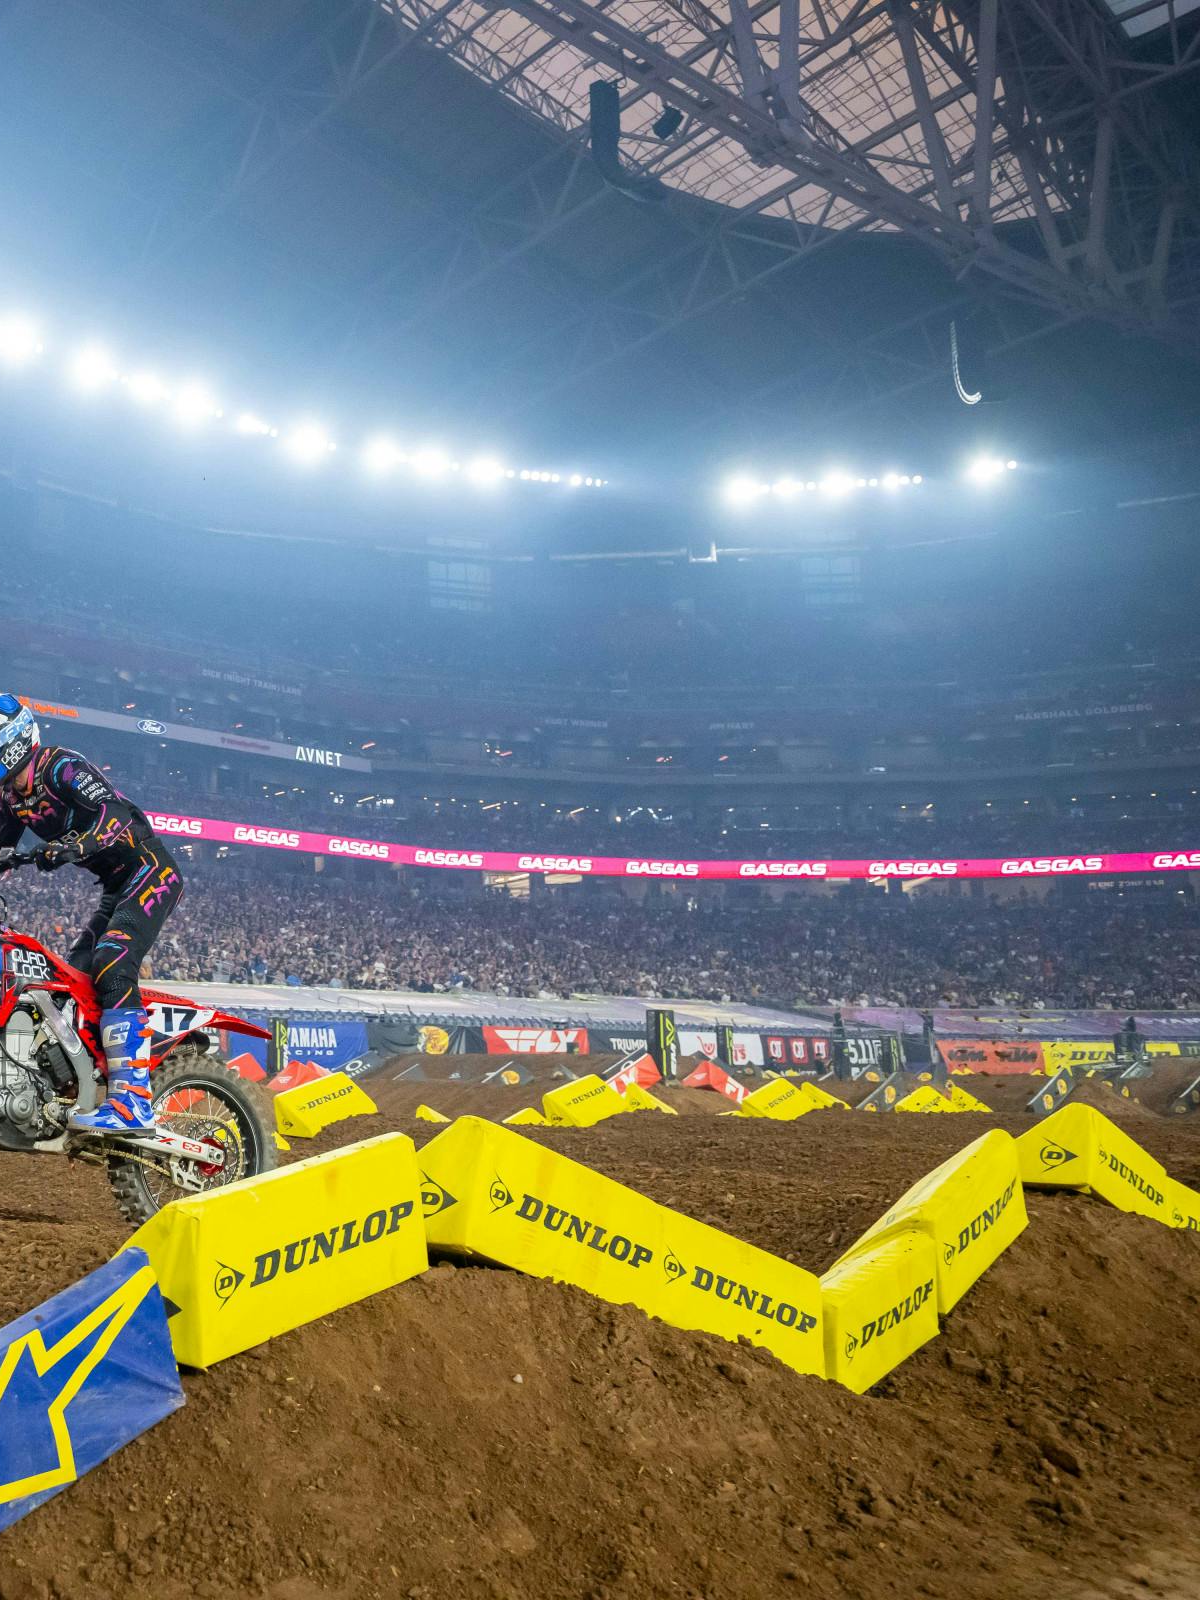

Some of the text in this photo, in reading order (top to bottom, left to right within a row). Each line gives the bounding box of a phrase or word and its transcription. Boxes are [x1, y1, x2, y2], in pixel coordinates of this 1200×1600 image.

[296, 746, 343, 767] AVNET
[147, 815, 203, 835] ASGAS
[234, 827, 300, 847] GASGAS
[328, 839, 389, 858] GASGAS
[414, 850, 484, 867] GASGAS
[517, 856, 593, 872] GASGAS
[625, 861, 699, 876] GASGAS
[739, 863, 827, 876] GASGAS
[868, 863, 958, 876] GASGAS
[1001, 857, 1103, 874] GASGAS
[1153, 853, 1200, 868] GAS
[11, 948, 47, 967] QUAD
[12, 962, 51, 980] LOCK
[161, 1006, 198, 1033] 17
[308, 1085, 355, 1109] DUNLOP
[571, 1085, 606, 1105] DUNLOP
[1109, 1153, 1165, 1207] DUNLOP
[958, 1177, 1017, 1255] DUNLOP
[514, 1193, 654, 1269] DUNLOP
[249, 1200, 414, 1289] DUNLOP
[690, 1265, 818, 1334] DUNLOP
[860, 1278, 934, 1349] DUNLOP
